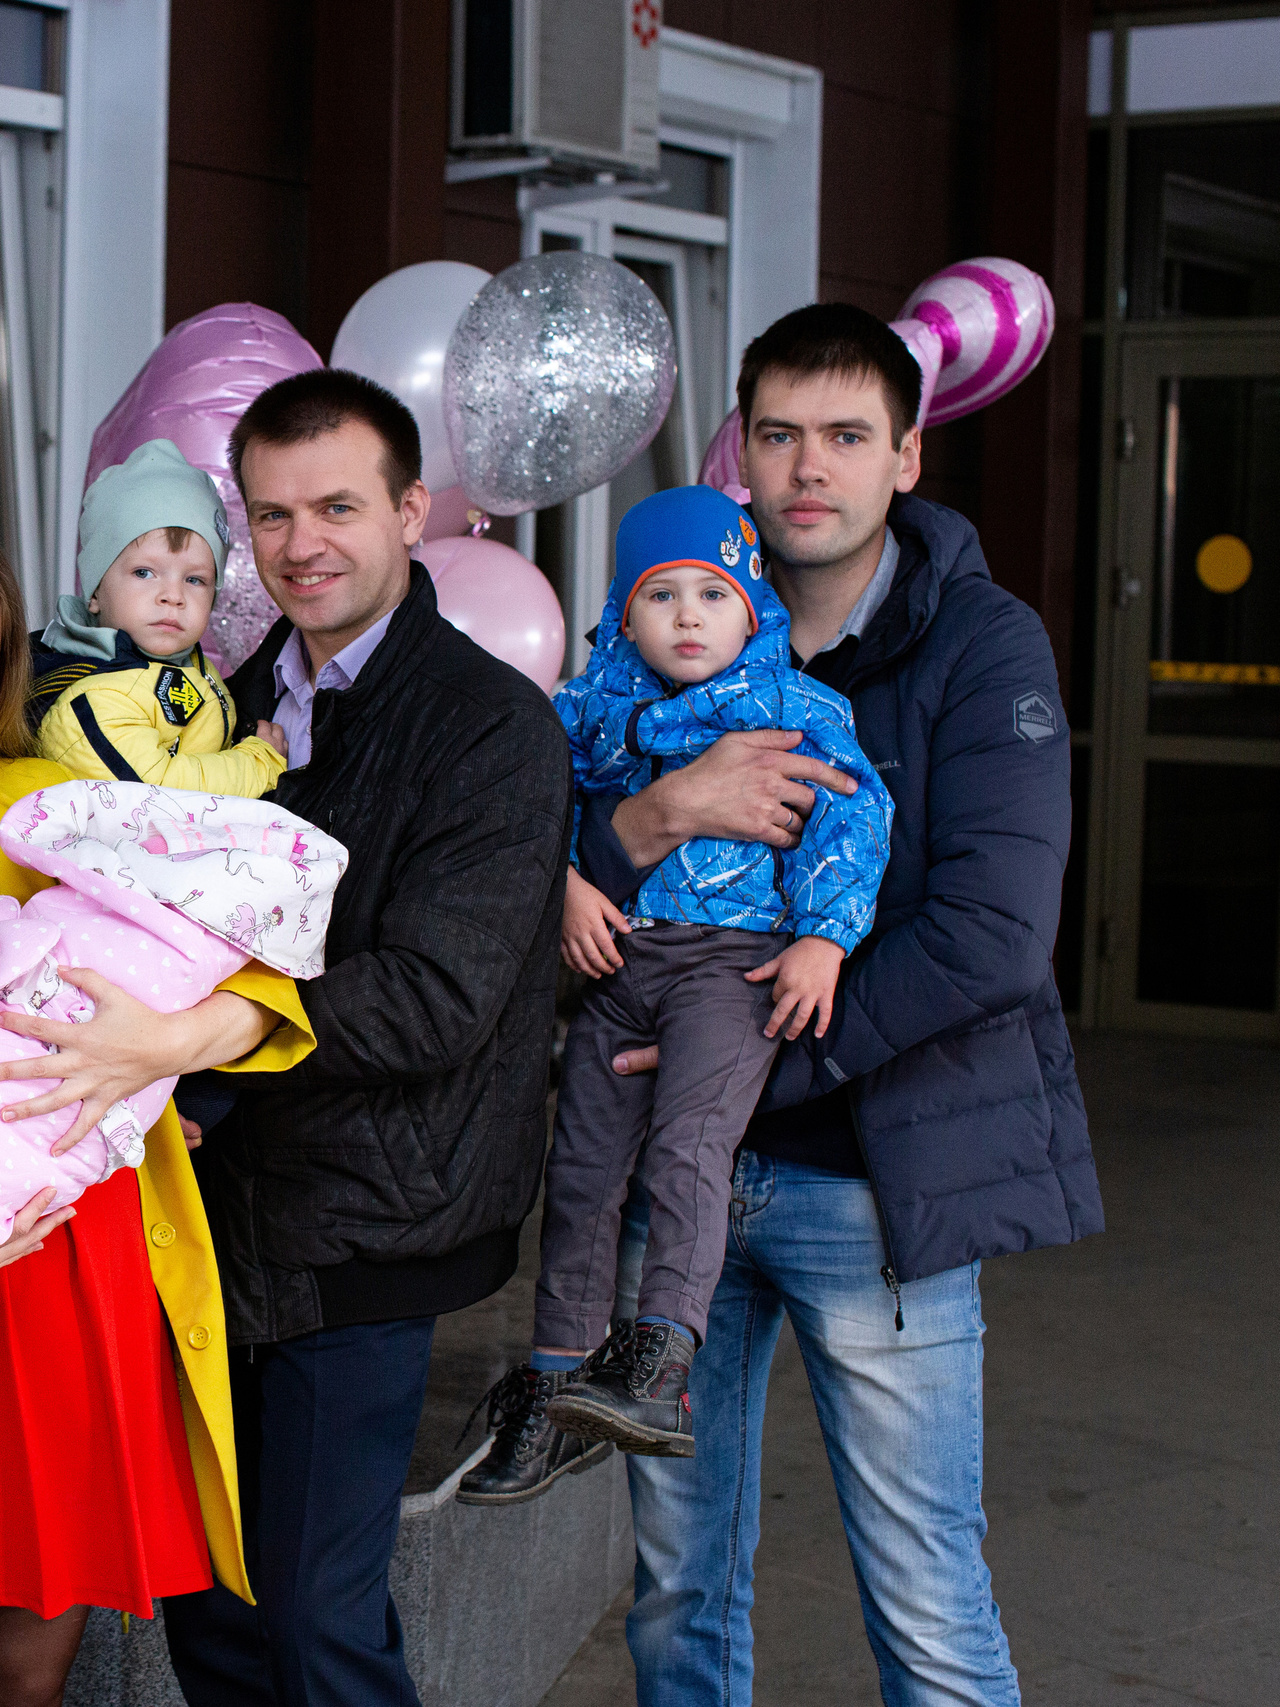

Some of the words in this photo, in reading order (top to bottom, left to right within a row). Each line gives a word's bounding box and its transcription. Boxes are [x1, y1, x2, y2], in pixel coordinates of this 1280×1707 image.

[157, 671, 172, 700] FASHION
[188, 694, 194, 708] RN
[161, 700, 176, 721] BEST
[1019, 714, 1053, 727] MERRELL
[873, 760, 901, 771] RRELL
